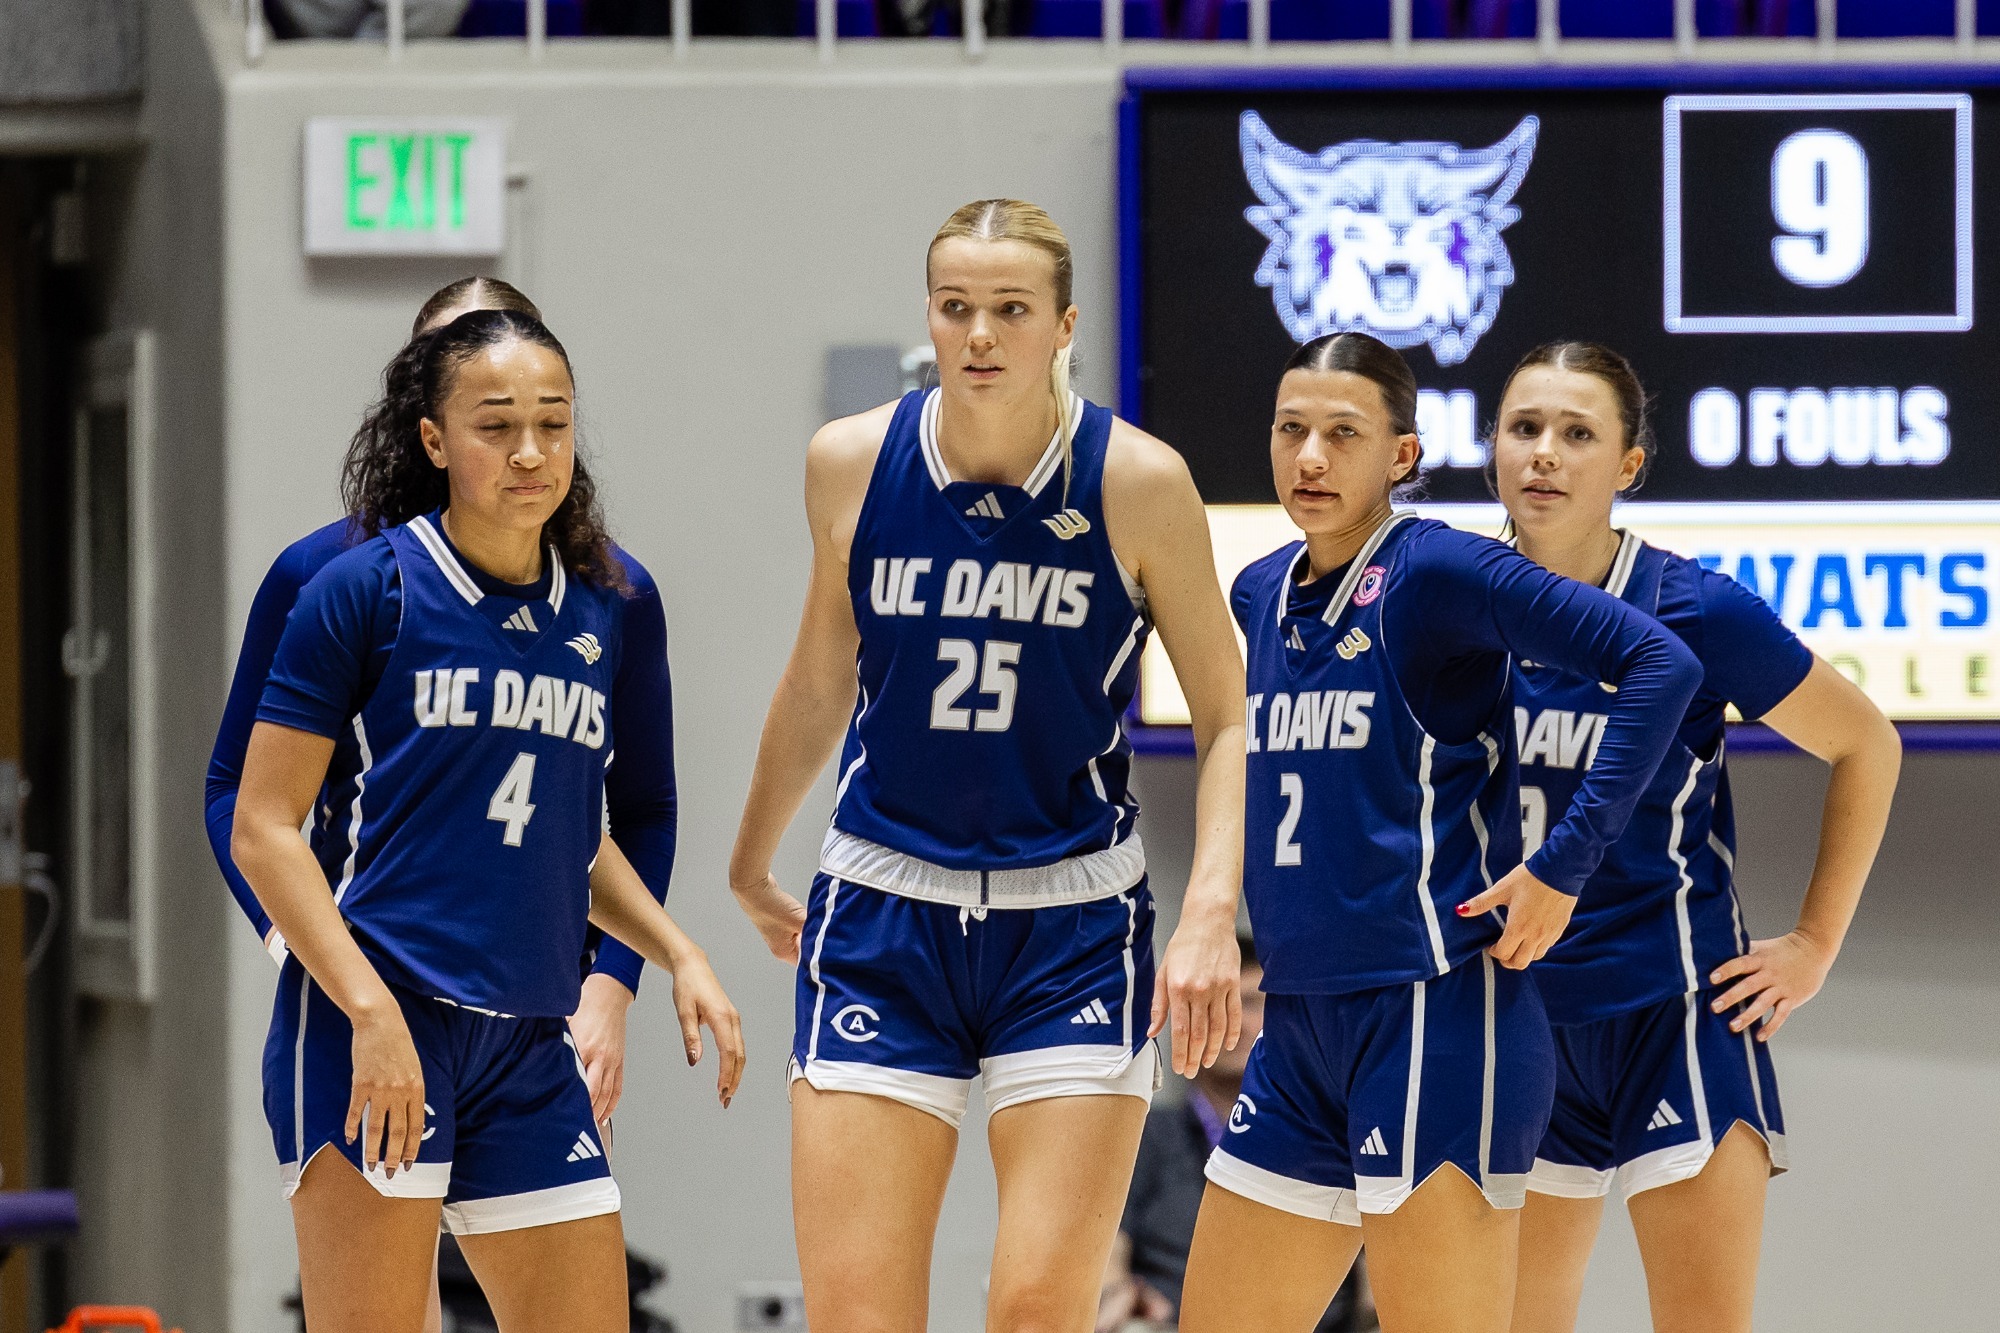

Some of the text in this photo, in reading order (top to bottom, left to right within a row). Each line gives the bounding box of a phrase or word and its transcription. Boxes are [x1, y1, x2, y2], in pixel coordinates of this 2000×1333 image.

[345, 131, 472, 231] EXIT
[1771, 128, 1869, 287] 9
[1416, 389, 1486, 468] OL
[1749, 386, 1950, 466] FOULS
[870, 557, 1095, 629] UC DAVIS
[414, 667, 606, 750] UC DAVIS
[929, 638, 1022, 732] 25
[1267, 690, 1376, 752] DAVIS
[486, 751, 537, 848] 4
[1274, 772, 1304, 867] 2
